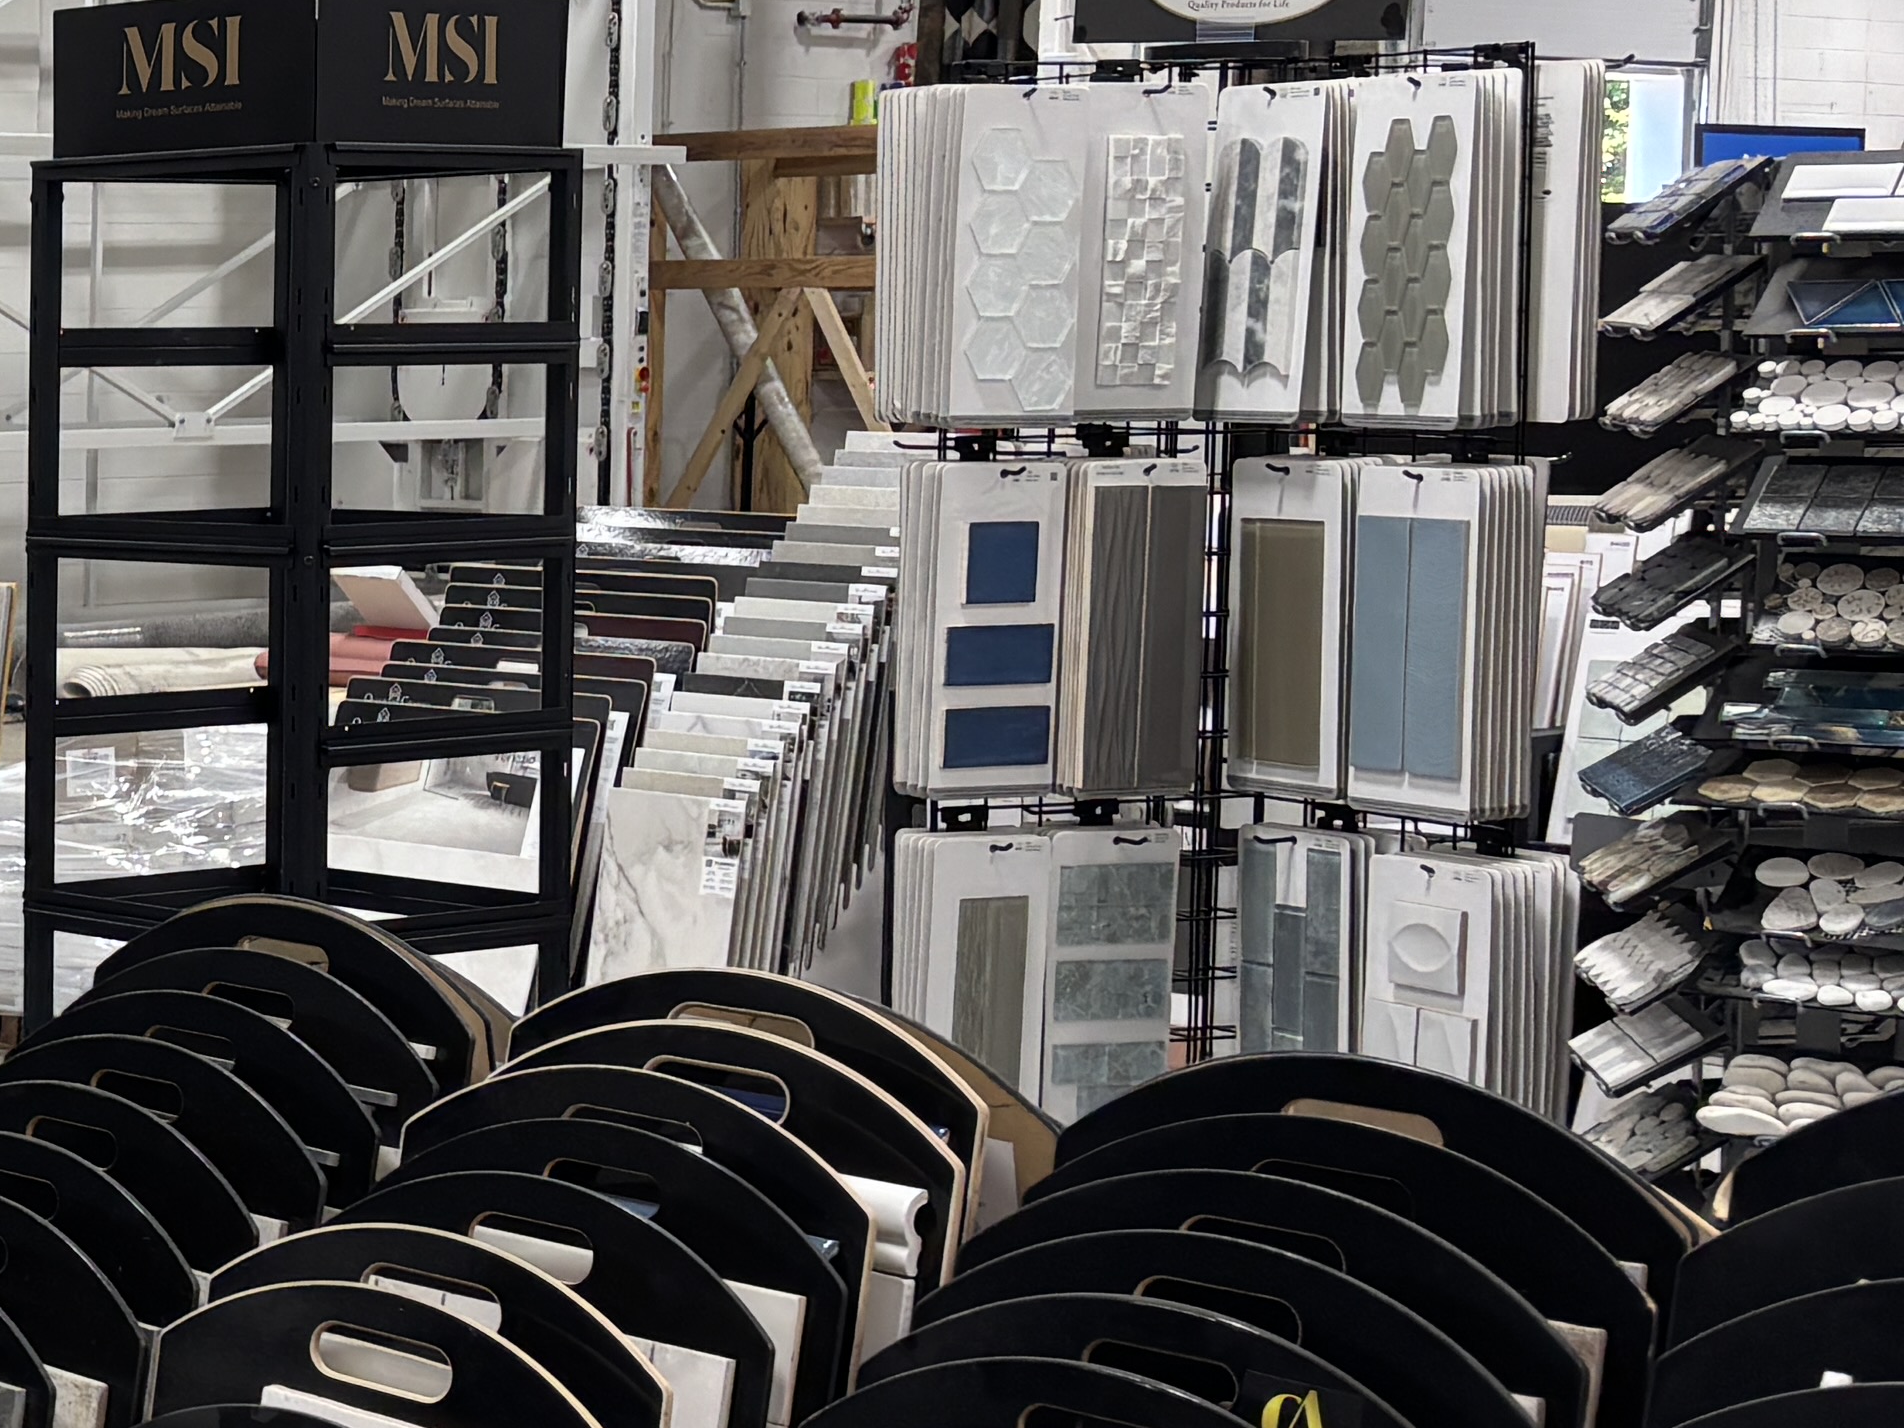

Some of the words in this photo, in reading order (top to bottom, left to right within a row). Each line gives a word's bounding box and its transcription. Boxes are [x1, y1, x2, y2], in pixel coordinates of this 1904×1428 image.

[1187, 0, 1220, 12] Quality
[1221, 0, 1257, 9] Products
[1258, 0, 1271, 9] for
[1273, 0, 1290, 9] Life
[117, 15, 242, 95] MSI
[383, 12, 499, 85] MSI
[115, 109, 143, 121] Making
[143, 107, 170, 118] Dream
[170, 104, 203, 116] Surfaces
[204, 100, 243, 113] Attainable
[381, 95, 408, 109] Making
[409, 96, 433, 108] Dream
[433, 97, 465, 109] Surfaces
